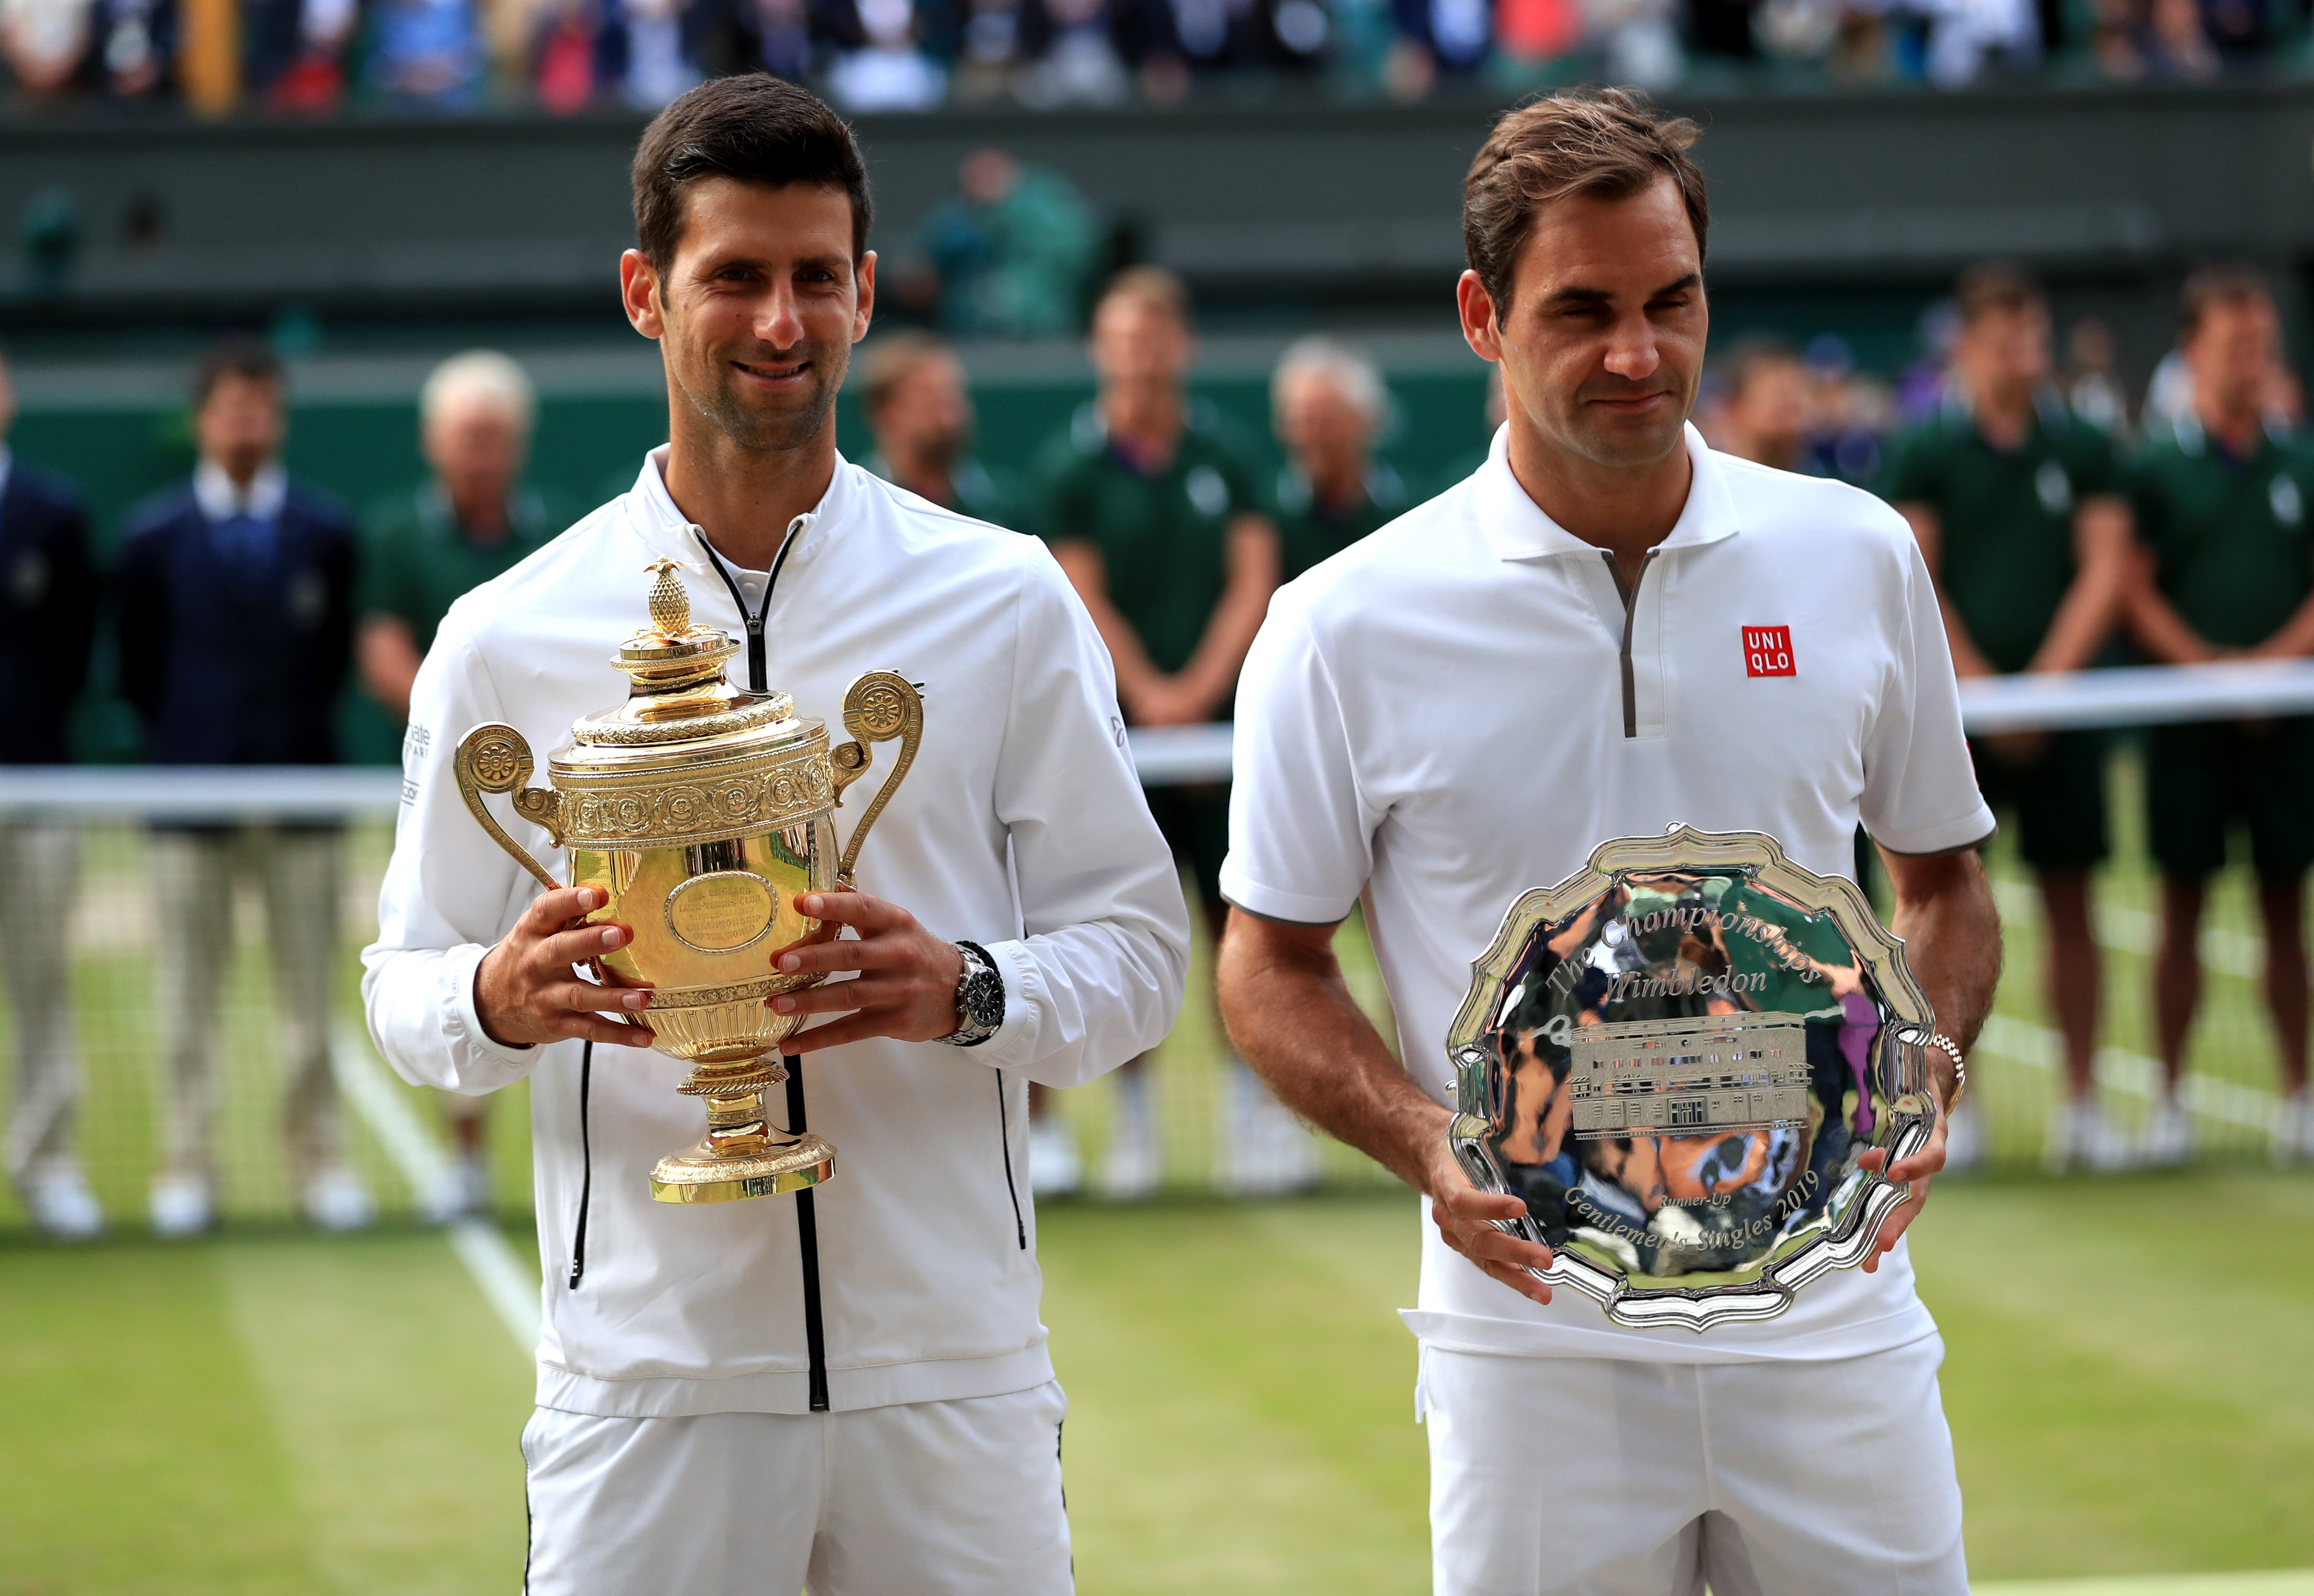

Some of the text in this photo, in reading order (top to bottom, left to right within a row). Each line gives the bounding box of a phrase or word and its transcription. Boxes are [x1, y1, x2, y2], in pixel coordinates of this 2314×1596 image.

[1748, 632, 1783, 649] UNI
[1751, 652, 1789, 673] QLO
[708, 886, 751, 896] ENGLAND
[1545, 902, 1822, 1000] The Championships
[1606, 964, 1767, 1003] Wimbledon
[1565, 1170, 1819, 1251] Gentlemen's Singles 2019
[1659, 1192, 1731, 1209] Runner-Up
